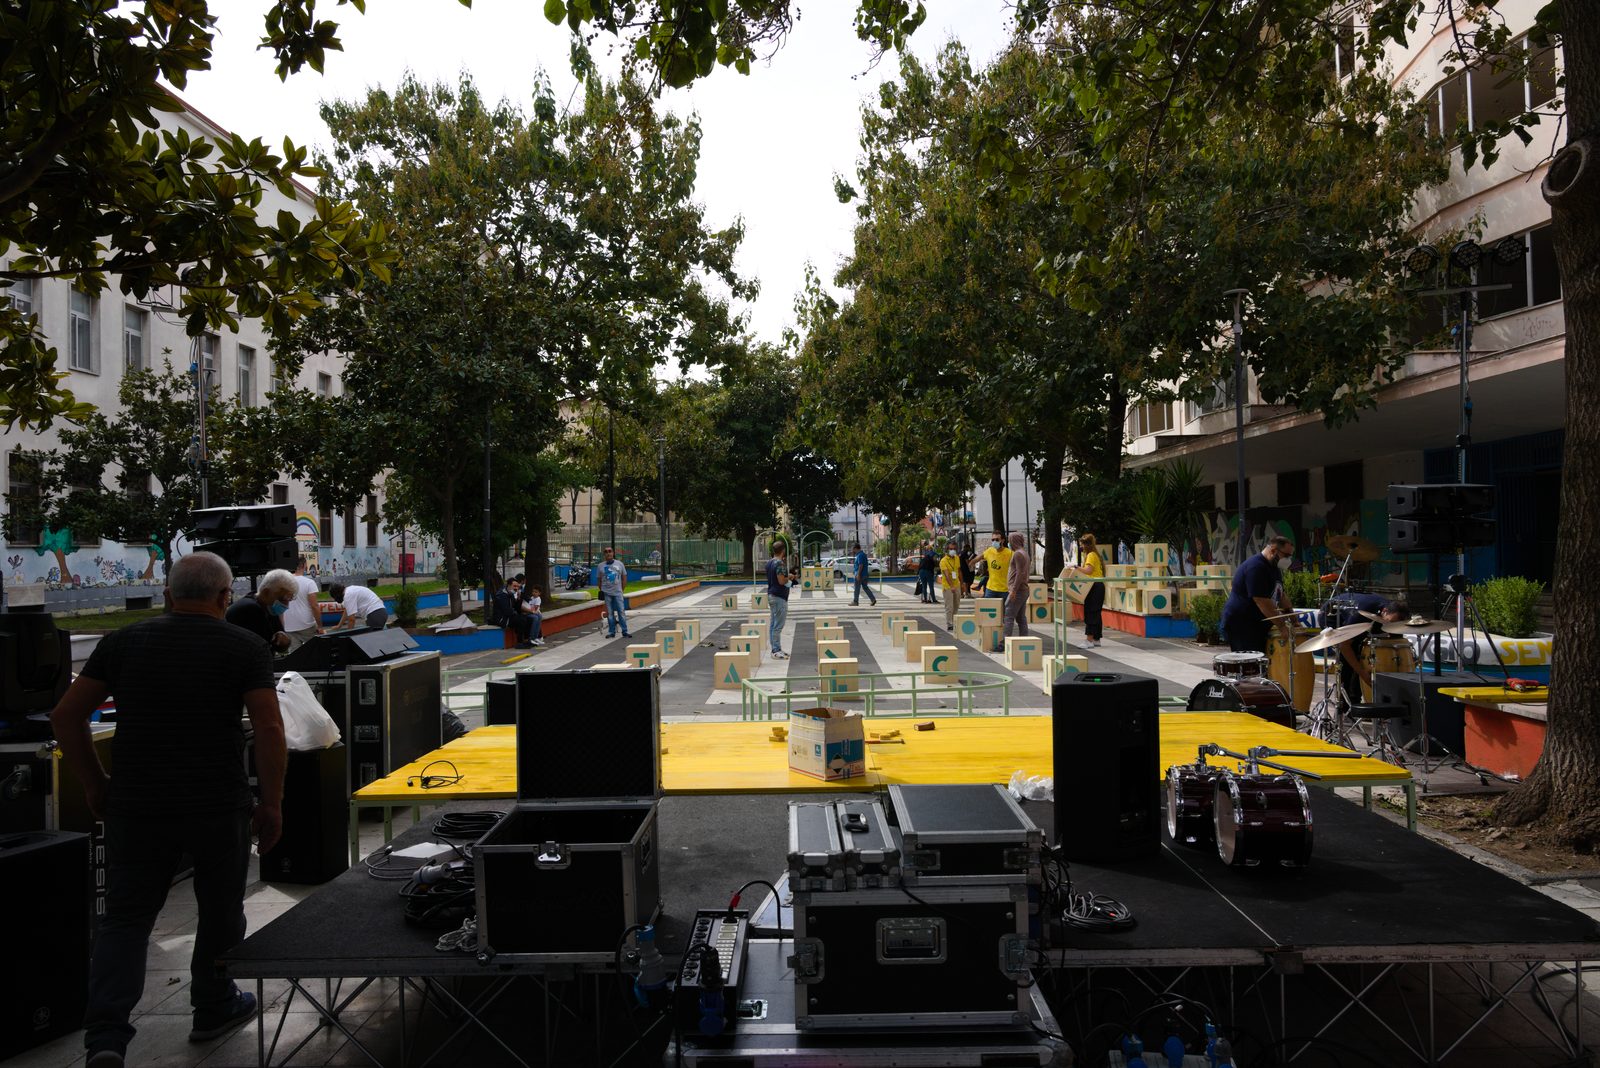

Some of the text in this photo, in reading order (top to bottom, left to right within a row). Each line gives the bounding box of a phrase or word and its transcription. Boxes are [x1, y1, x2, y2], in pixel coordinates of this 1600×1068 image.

[1018, 645, 1036, 665] T
[723, 662, 741, 683] A
[931, 655, 949, 677] C
